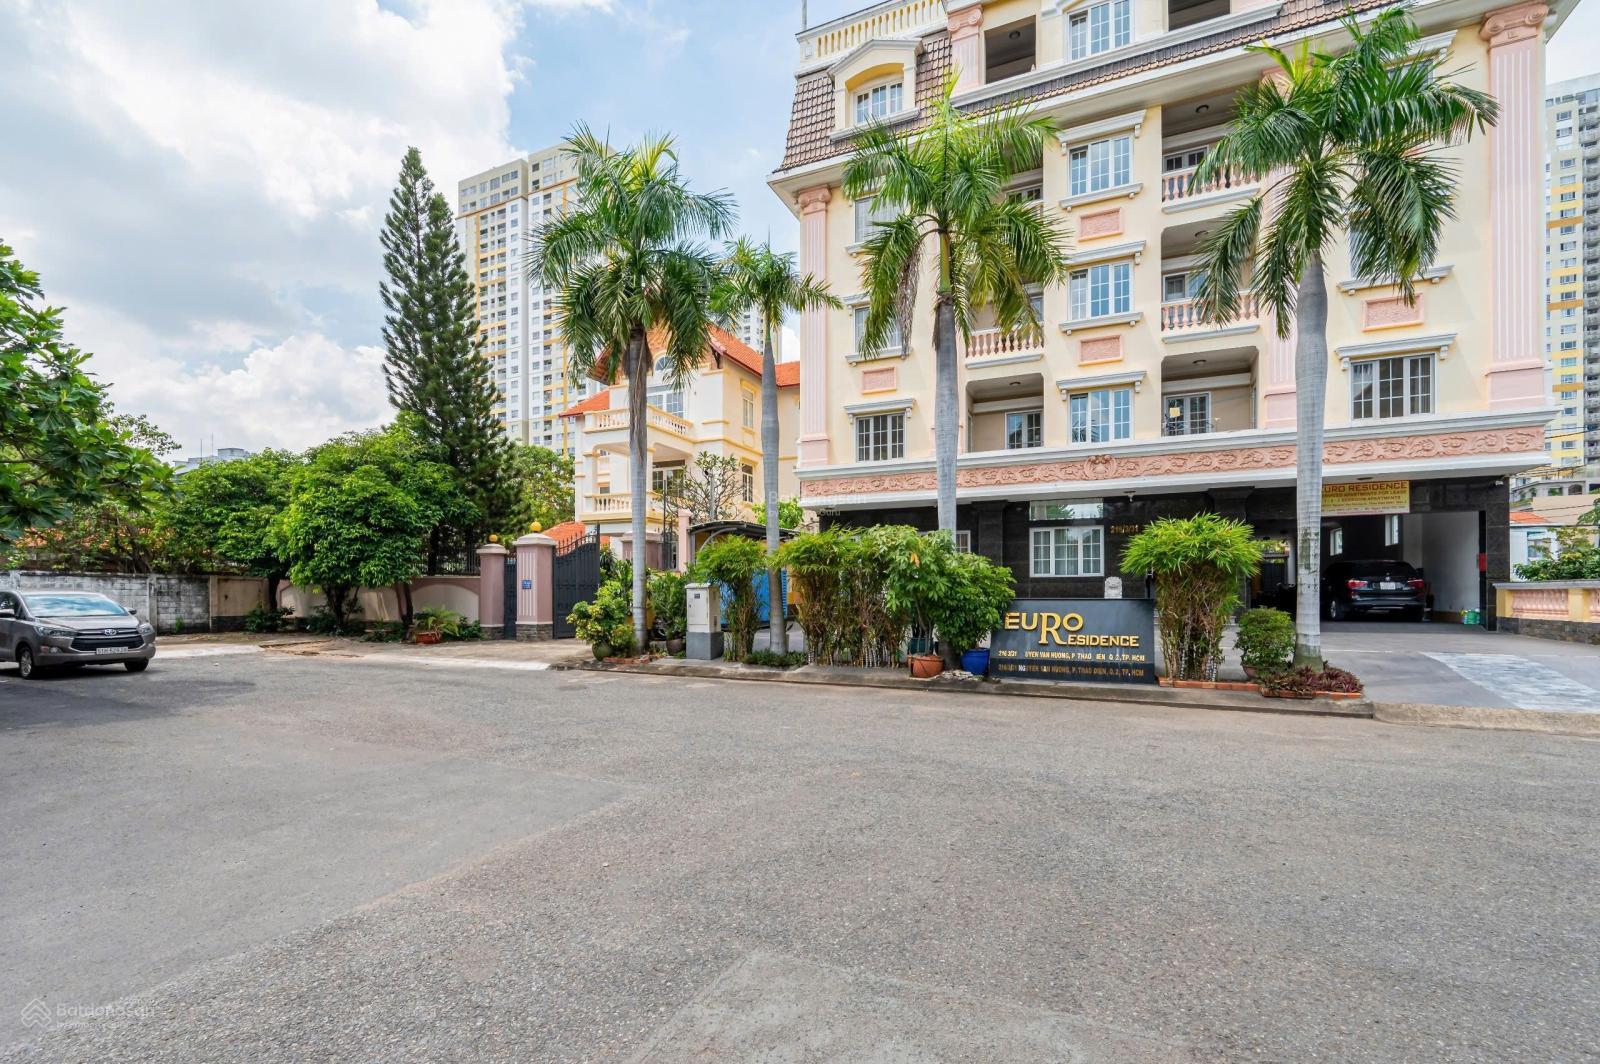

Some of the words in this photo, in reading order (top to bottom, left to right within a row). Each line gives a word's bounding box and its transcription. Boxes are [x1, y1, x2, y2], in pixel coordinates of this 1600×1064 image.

[1321, 484, 1346, 493] URO
[1348, 481, 1407, 492] RESIDENCE
[1004, 612, 1084, 645] EURO
[1132, 654, 1145, 662] HCM
